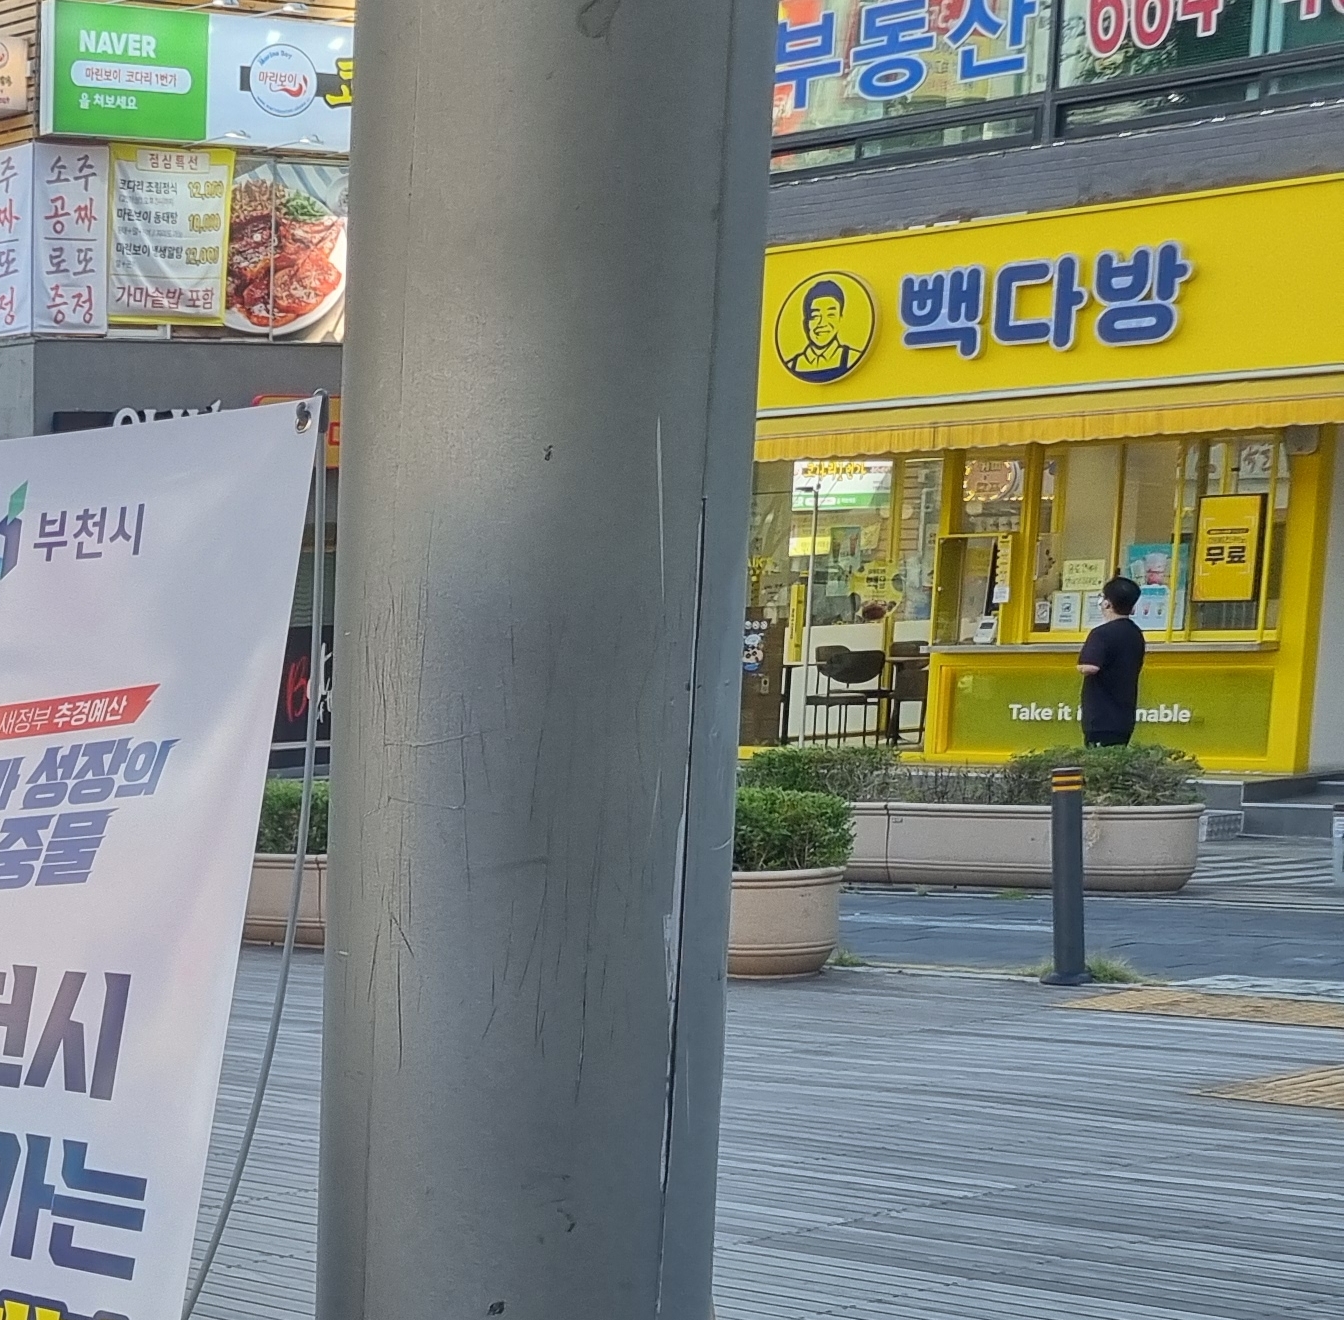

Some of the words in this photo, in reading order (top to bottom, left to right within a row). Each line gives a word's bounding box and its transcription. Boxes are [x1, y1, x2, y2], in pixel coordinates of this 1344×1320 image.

[79, 29, 157, 58] NAVER
[774, 0, 1043, 113] 부동산
[84, 66, 122, 83] 마린보이
[125, 70, 153, 86] 코다리
[155, 72, 178, 88] 1번가
[78, 96, 91, 109] 을
[45, 153, 98, 192] 소주
[43, 195, 98, 236] 공짜
[44, 245, 96, 277] 로또
[45, 283, 95, 325] 증정
[115, 284, 184, 309] 가마솥밥
[185, 287, 215, 310] 포함
[899, 241, 1196, 361] 빽다방
[32, 503, 146, 563] 부천시
[1205, 545, 1247, 566] 무료
[52, 695, 129, 729] 추경예산
[1008, 702, 1054, 722] Take
[1057, 702, 1072, 722] it
[1135, 703, 1192, 723] nable
[19, 737, 182, 812] 성장의
